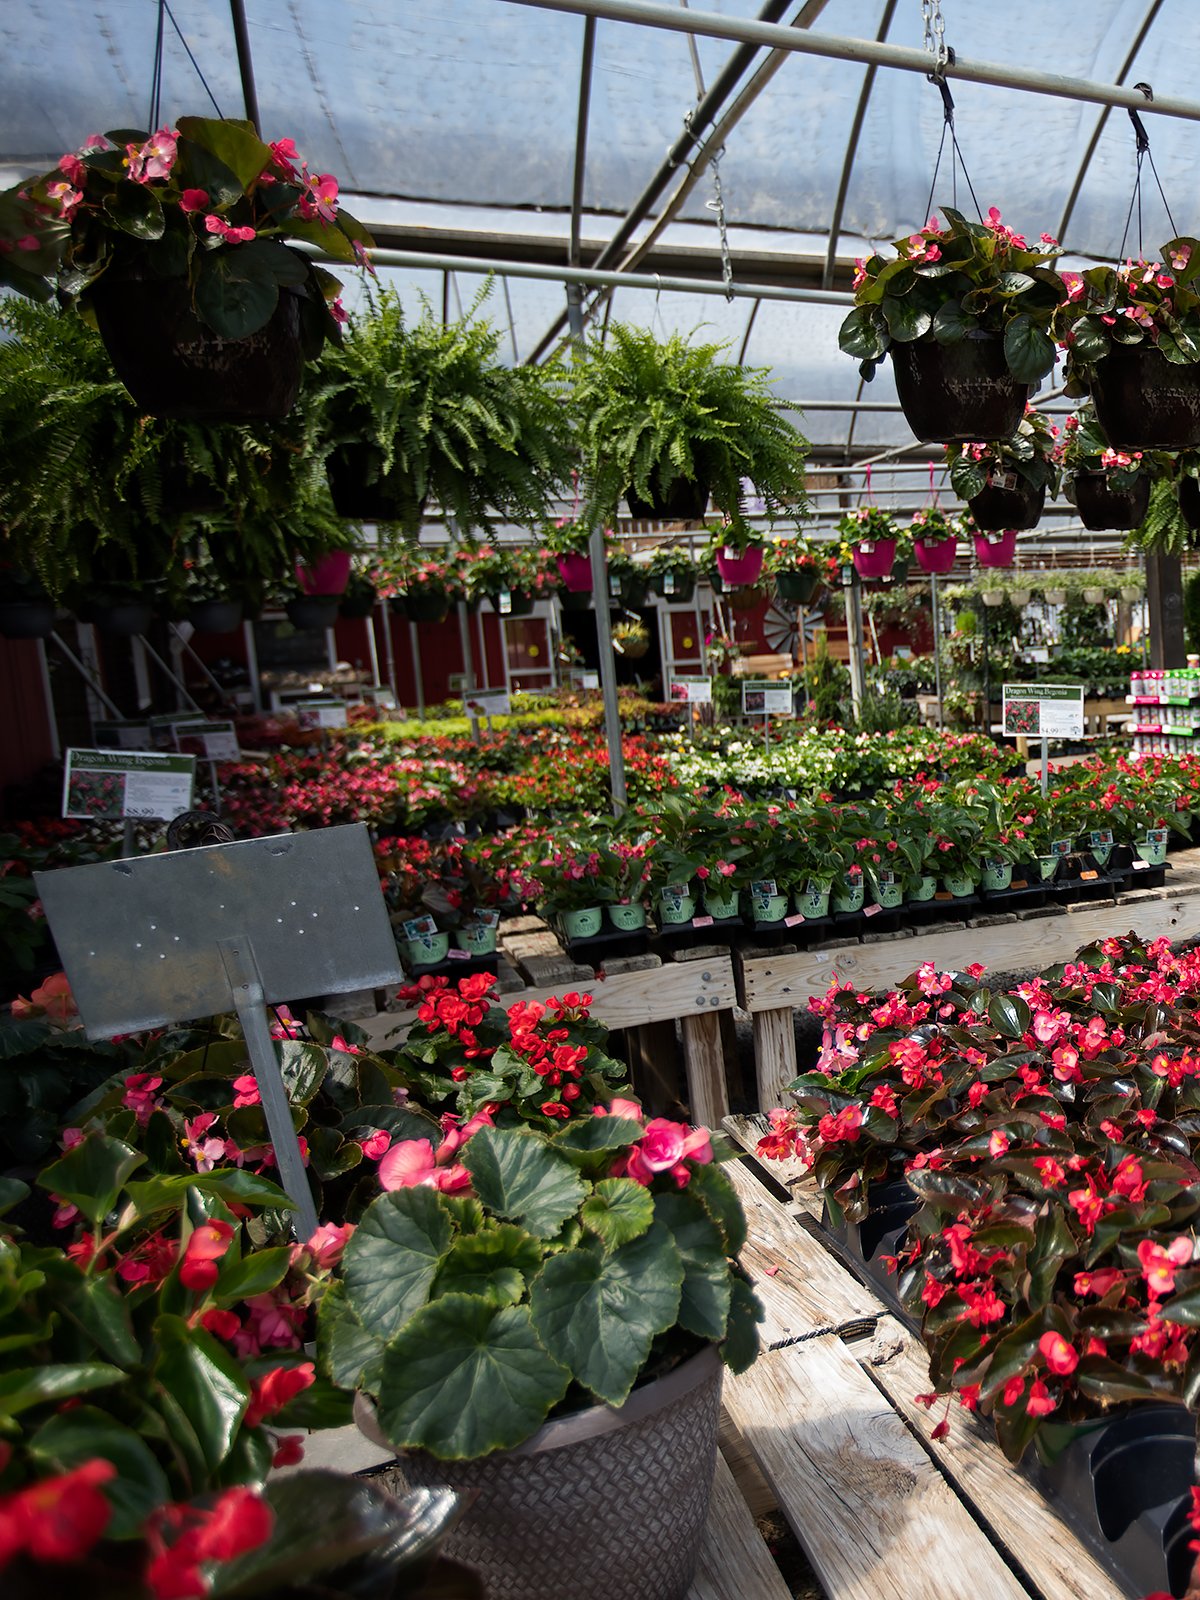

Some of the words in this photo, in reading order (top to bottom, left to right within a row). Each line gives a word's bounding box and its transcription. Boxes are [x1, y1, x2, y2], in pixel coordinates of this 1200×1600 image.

[1006, 687, 1027, 695] Dragon
[71, 750, 106, 763] Dragon
[107, 753, 134, 765] Wing
[135, 755, 171, 766] Begonia
